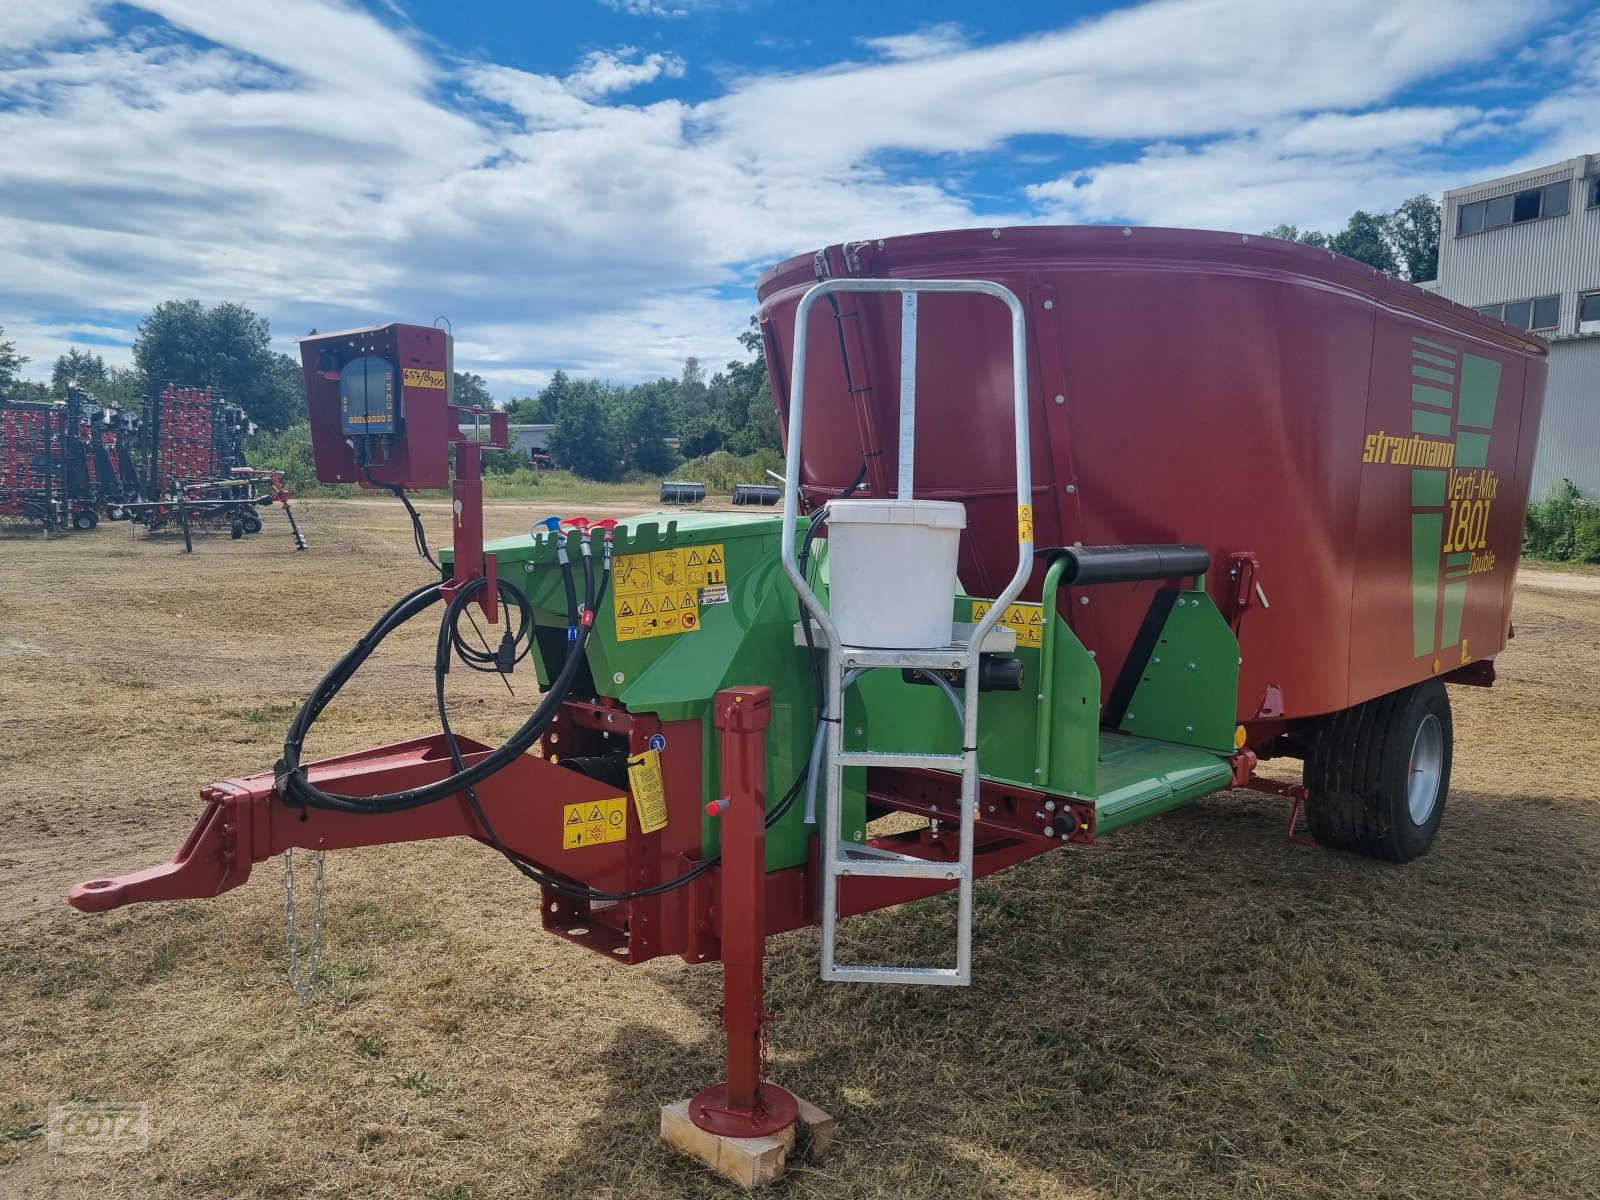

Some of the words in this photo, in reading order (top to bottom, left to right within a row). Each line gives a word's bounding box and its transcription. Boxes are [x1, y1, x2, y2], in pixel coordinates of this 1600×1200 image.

[404, 369, 444, 387] 657/8900
[1362, 430, 1455, 468] strautmann
[1448, 468, 1499, 500] Verti-Mix
[1443, 499, 1491, 553] 1801
[1468, 550, 1496, 575] Double
